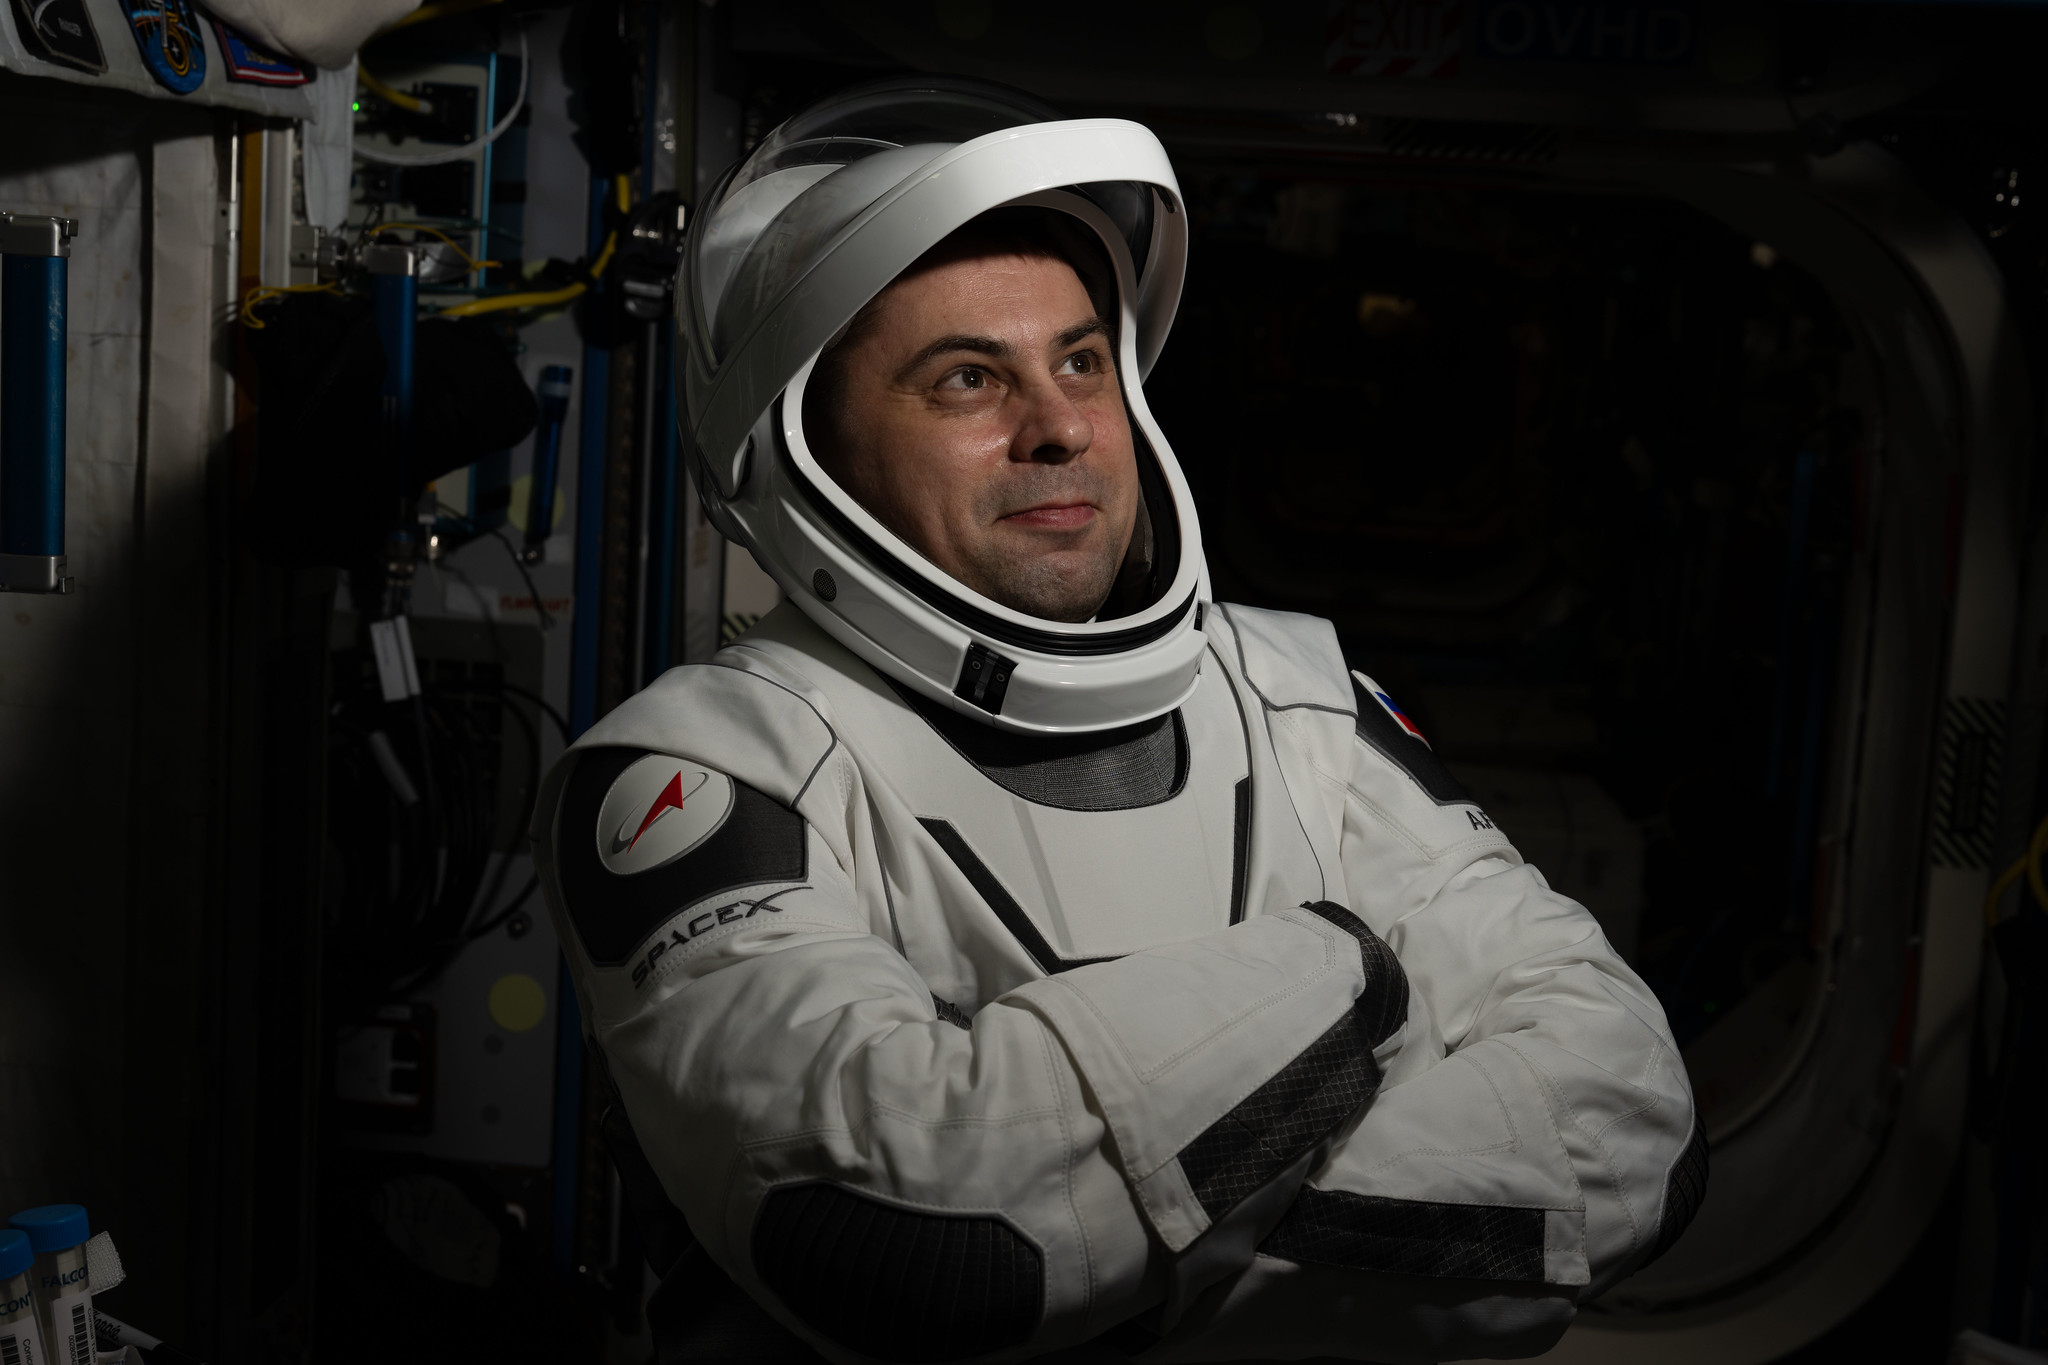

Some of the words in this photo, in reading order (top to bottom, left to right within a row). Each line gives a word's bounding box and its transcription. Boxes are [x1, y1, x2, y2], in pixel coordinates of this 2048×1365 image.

[1347, 0, 1441, 50] EXIT
[1484, 1, 1694, 61] OVHD
[631, 886, 814, 990] SPACEX
[42, 1264, 88, 1289] FALCO
